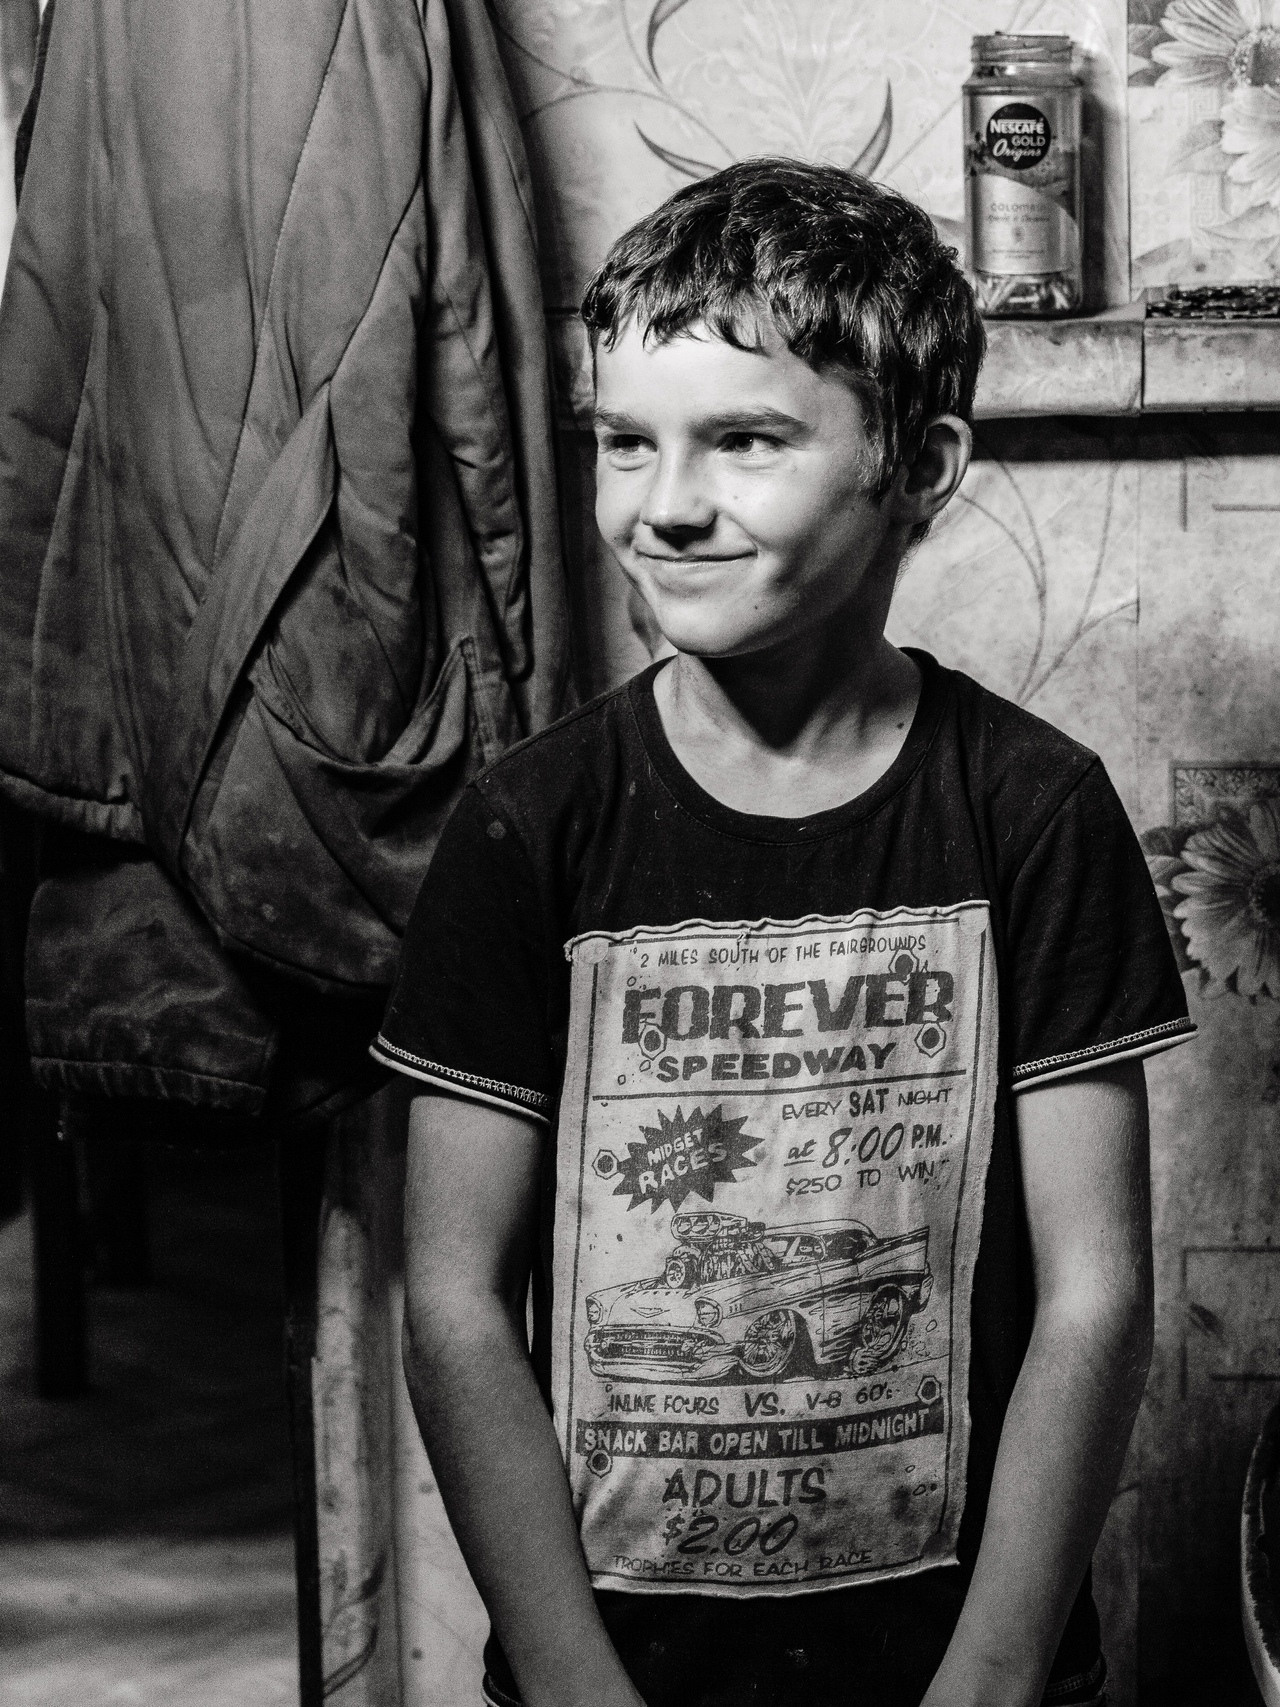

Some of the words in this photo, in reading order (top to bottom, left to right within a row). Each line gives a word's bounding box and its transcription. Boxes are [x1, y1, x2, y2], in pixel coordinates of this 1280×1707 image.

[992, 138, 1041, 162] Origins
[1011, 135, 1046, 147] GOLD
[640, 953, 650, 968] 2
[658, 948, 698, 967] MILES
[708, 947, 759, 965] SOUTH
[768, 947, 788, 964] OF
[796, 942, 821, 961] THE
[829, 935, 926, 957] FAIRGROUNDS
[621, 970, 955, 1045] FOREVER
[656, 1042, 897, 1084] SPEEDWAY
[782, 1100, 843, 1121] EVERY
[849, 1088, 890, 1118] SAT
[898, 1088, 954, 1107] NIGHT
[647, 1128, 706, 1166] MIDGET
[822, 1122, 905, 1169] 8:00
[911, 1123, 947, 1150] P.M.
[638, 1142, 729, 1194] RACES
[785, 1174, 843, 1196] $250
[856, 1168, 882, 1188] TO
[664, 1394, 720, 1415] FOURS
[744, 1392, 786, 1417] VS.
[806, 1391, 842, 1411] V-8
[583, 1428, 648, 1453] SNACK
[659, 1430, 699, 1454] BAR
[710, 1431, 768, 1456] OPEN
[778, 1427, 824, 1452] TILL
[835, 1408, 930, 1445] MIDNIGHT
[662, 1467, 827, 1508] ADULTS
[662, 1513, 799, 1556] $2.00
[613, 1555, 694, 1576] TROPHIES
[703, 1562, 743, 1577] FOR
[753, 1559, 808, 1577] EACH
[820, 1551, 873, 1570] RACE
